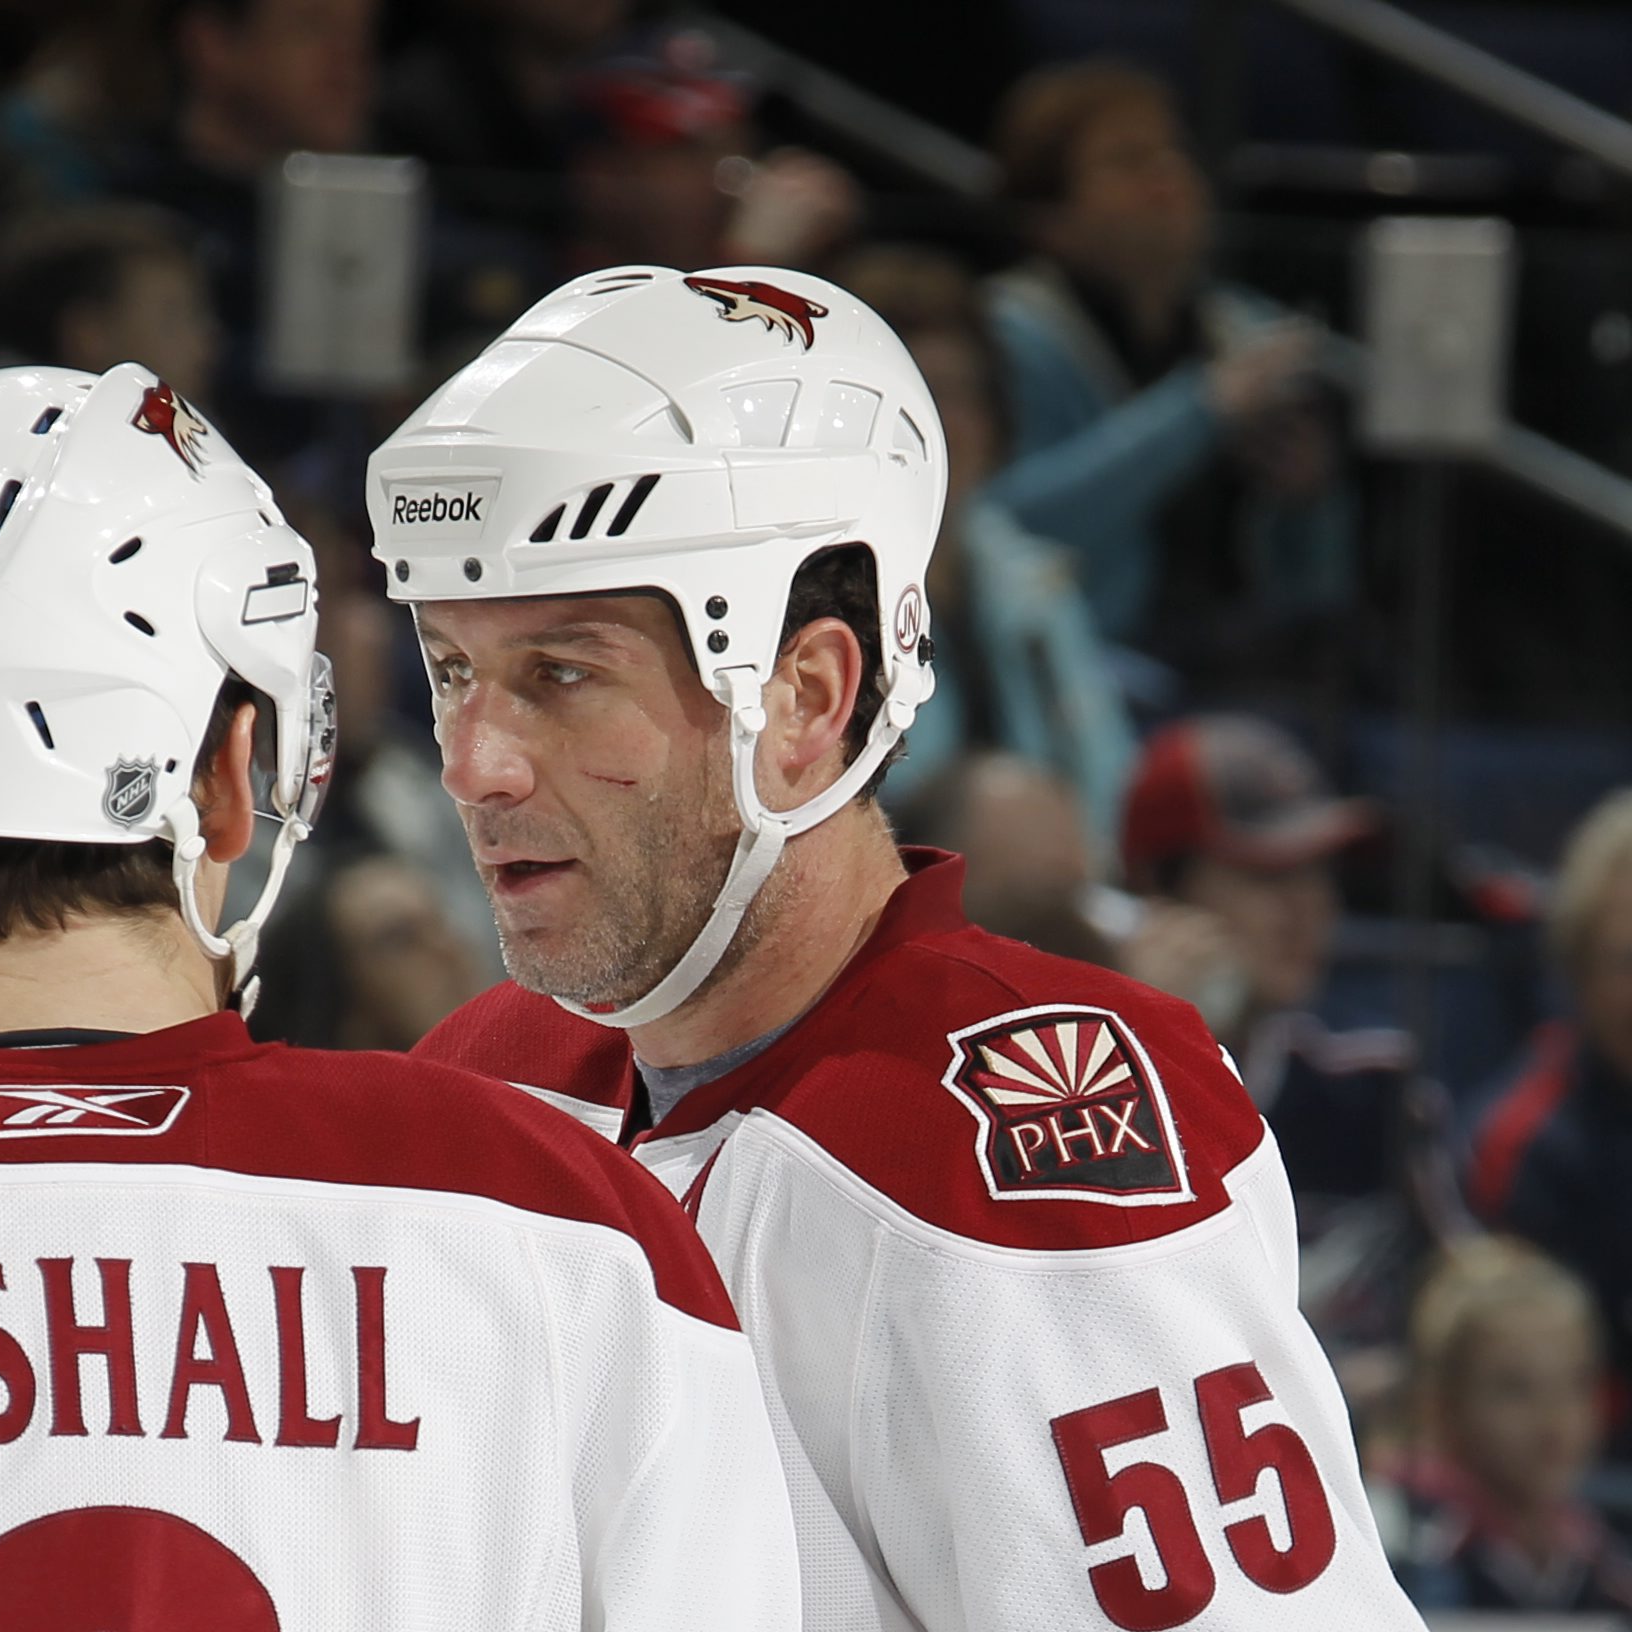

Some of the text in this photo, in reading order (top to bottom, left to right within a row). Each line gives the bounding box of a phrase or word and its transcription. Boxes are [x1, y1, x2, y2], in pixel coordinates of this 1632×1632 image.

[392, 492, 483, 525] Reebok
[898, 598, 918, 639] JN
[115, 777, 149, 811] NHL
[1006, 1098, 1155, 1175] PHX
[1049, 1360, 1337, 1632] 55
